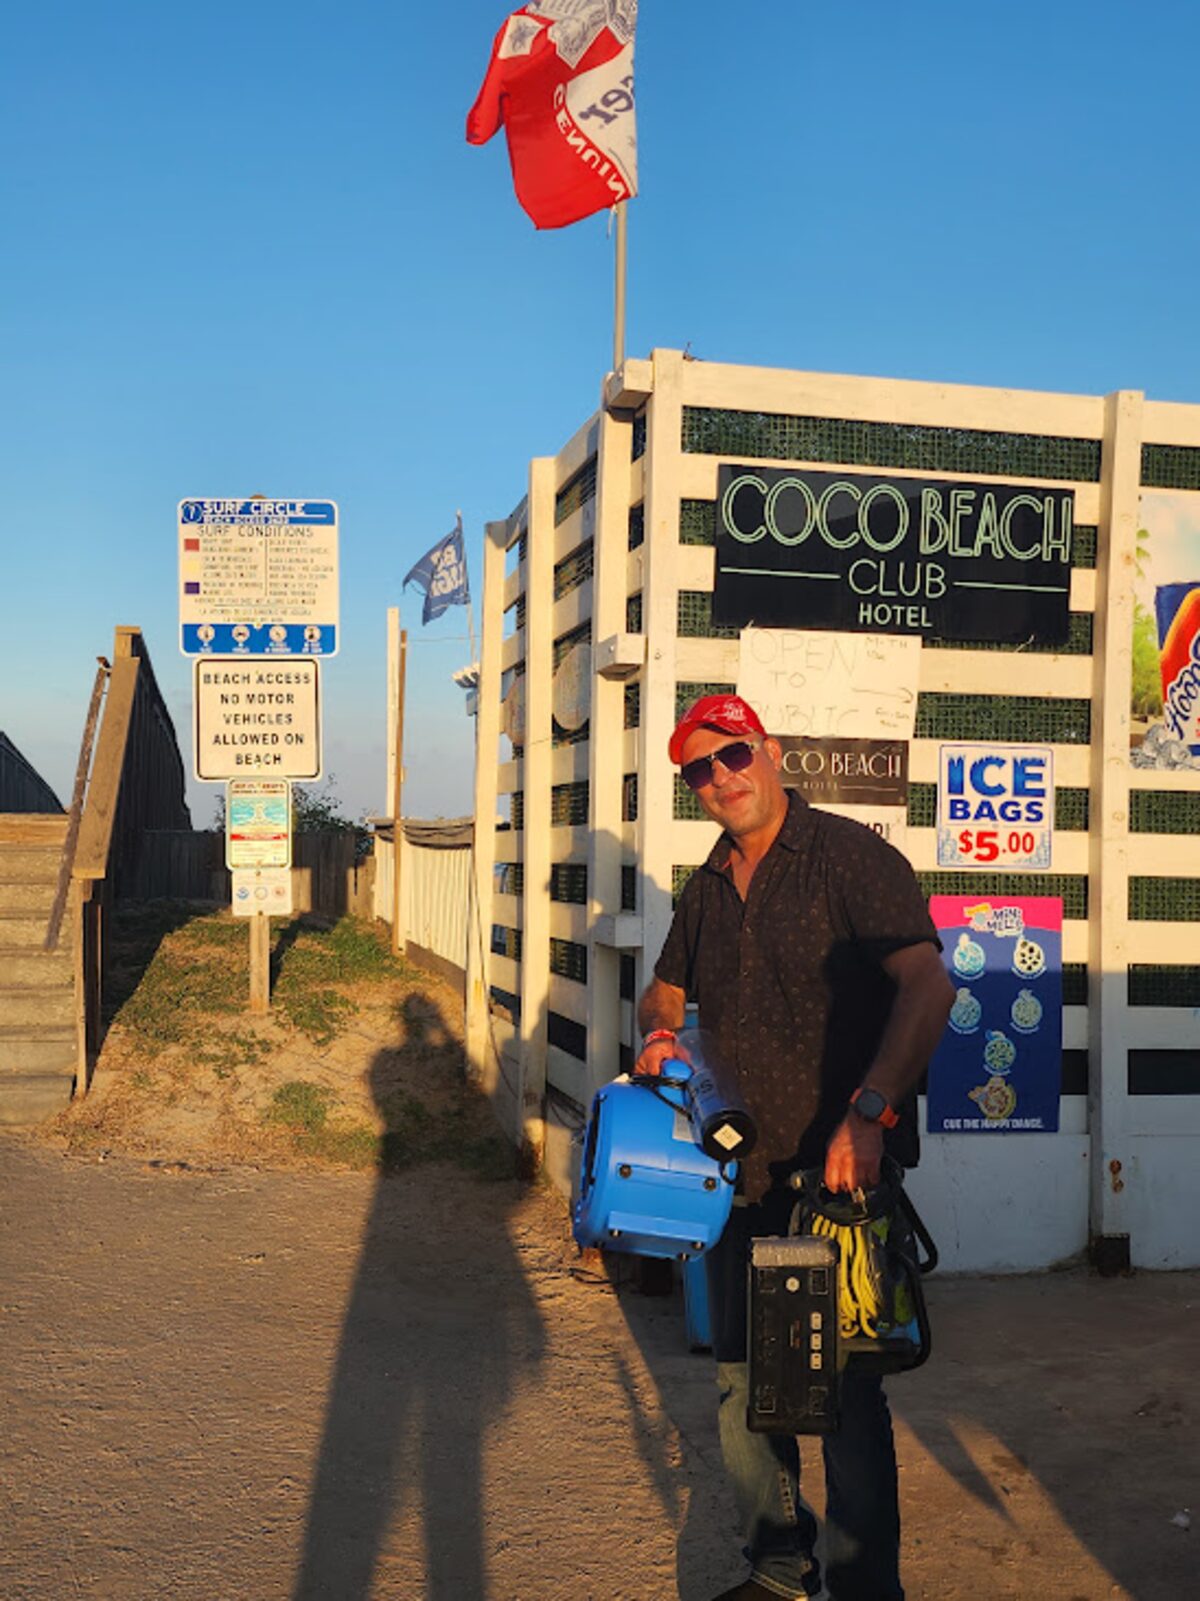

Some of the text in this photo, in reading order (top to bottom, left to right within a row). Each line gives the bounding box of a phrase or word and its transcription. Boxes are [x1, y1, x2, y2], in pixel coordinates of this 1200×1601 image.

[203, 501, 305, 515] SURF CIRCLE
[721, 475, 1072, 563] COCO BEACH
[198, 526, 313, 537] SURF CONDITIONS
[848, 559, 947, 598] CLUB
[858, 603, 932, 627] HOTEL
[751, 631, 857, 676] OPEN
[203, 673, 312, 685] BEACH ACCESS
[769, 670, 806, 688] TO
[220, 693, 295, 705] NO MOTOR
[223, 713, 293, 726] VEHICLES
[212, 733, 305, 746] ALLOWED ON
[235, 753, 283, 766] BEACH
[782, 750, 901, 778] CO BEACH
[947, 754, 1046, 798] ICE
[948, 799, 1045, 823] BAGS
[958, 831, 1035, 862] $5.00
